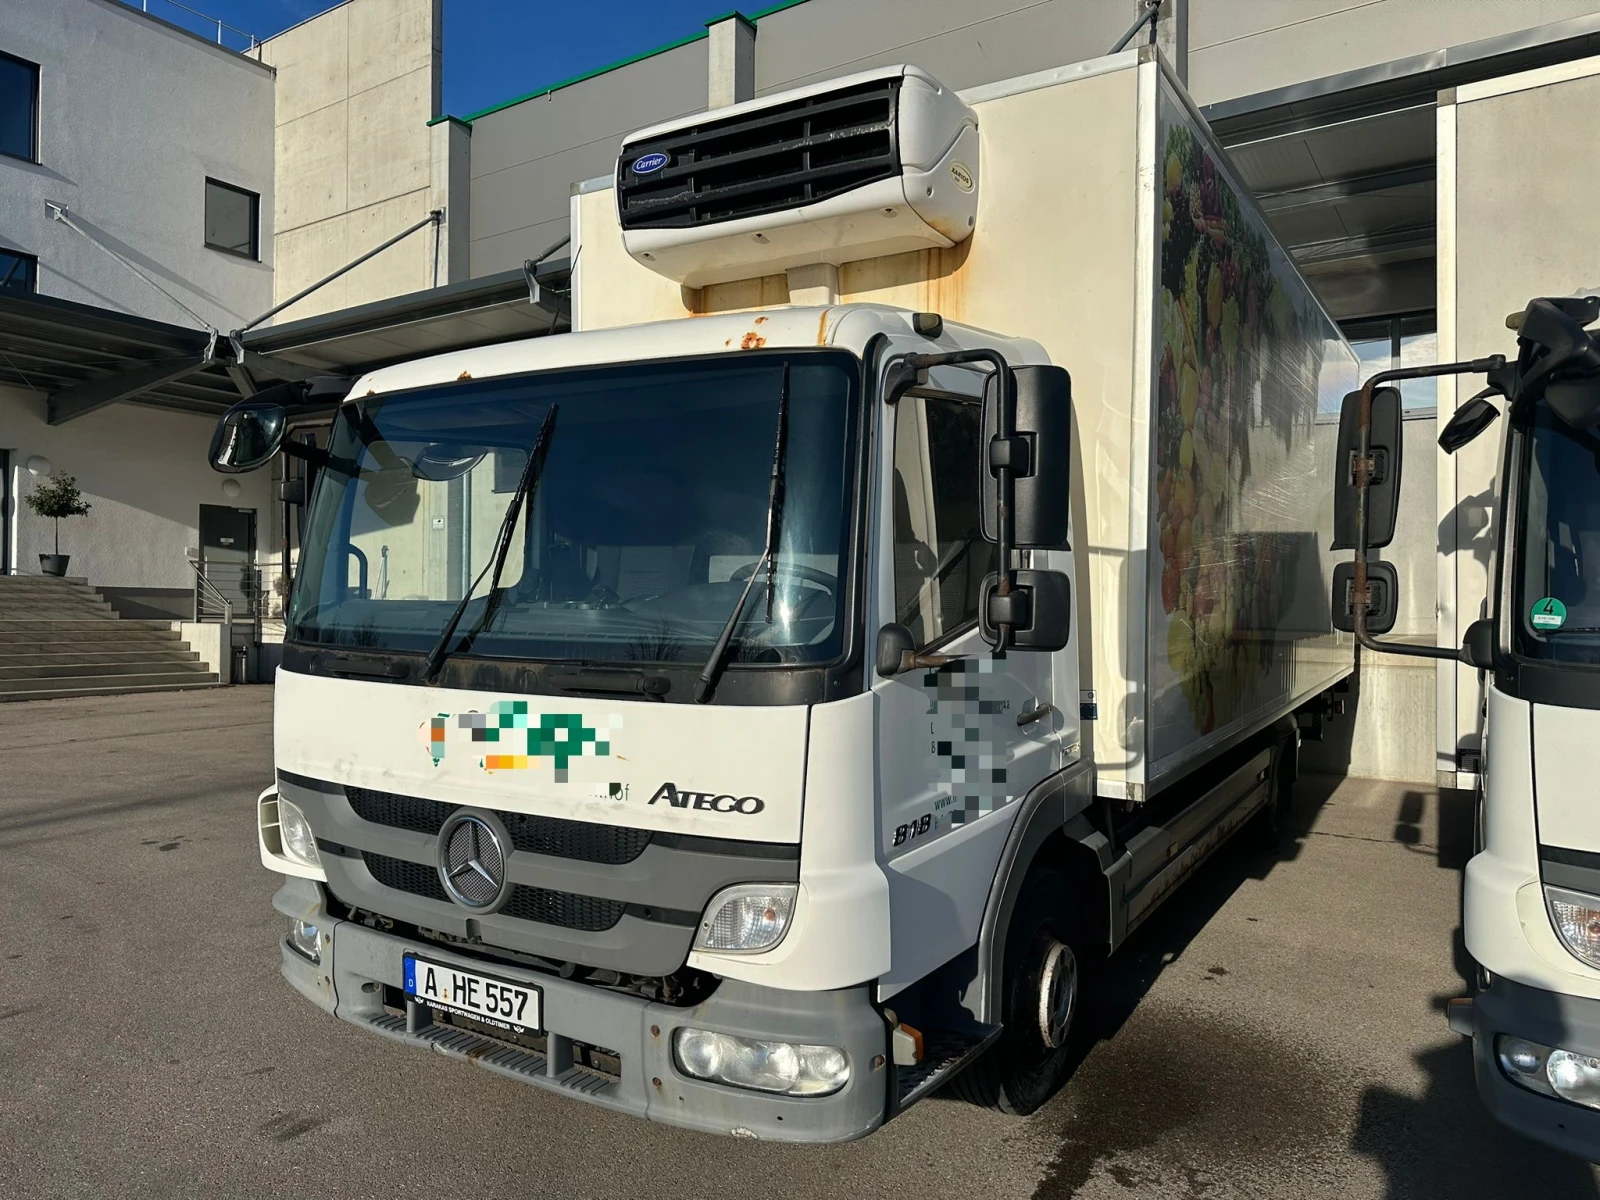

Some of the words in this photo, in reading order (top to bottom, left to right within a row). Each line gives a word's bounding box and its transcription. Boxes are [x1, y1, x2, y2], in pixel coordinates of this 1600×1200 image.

[636, 157, 663, 170] Carrier
[1543, 598, 1554, 615] 4
[892, 813, 931, 847] 818
[425, 967, 437, 997] A
[486, 983, 528, 1020] 557
[449, 1007, 480, 1021] SPORTWAGEN
[486, 1018, 510, 1029] OLDTIMER
